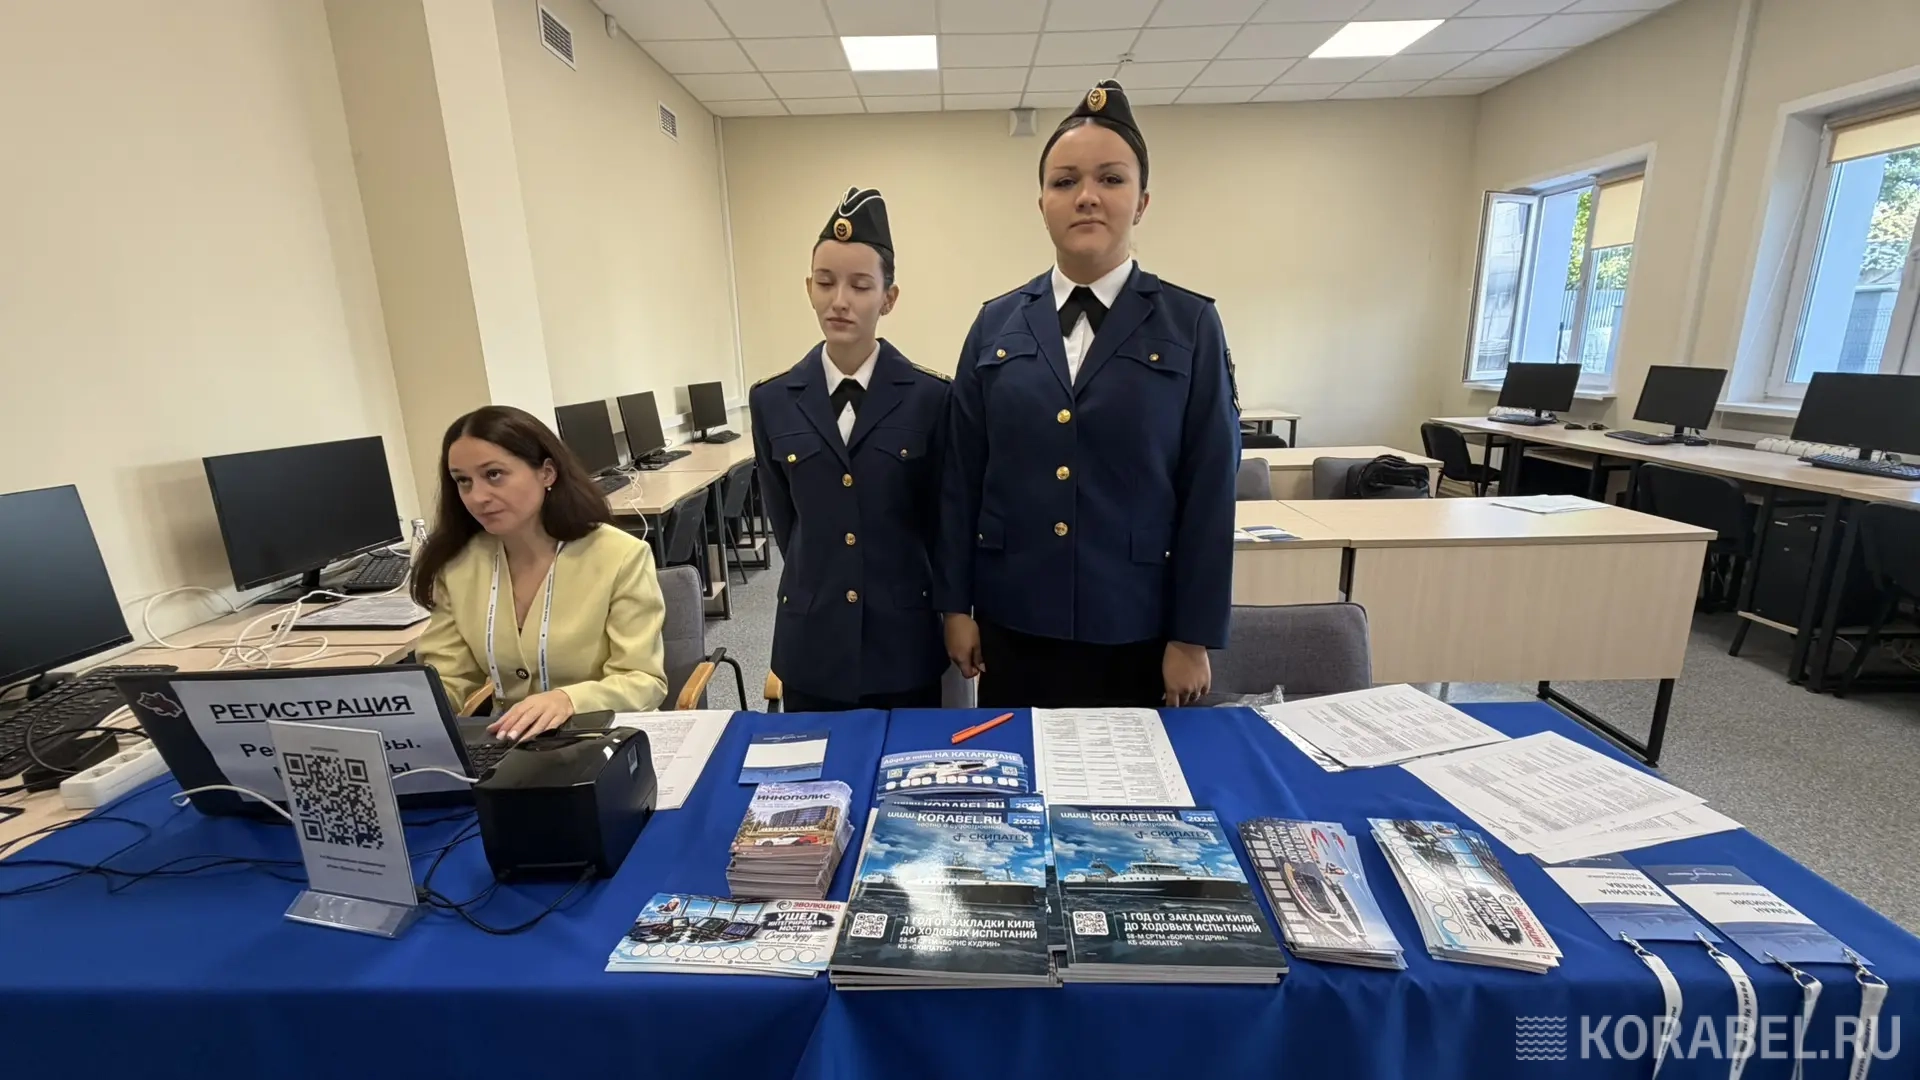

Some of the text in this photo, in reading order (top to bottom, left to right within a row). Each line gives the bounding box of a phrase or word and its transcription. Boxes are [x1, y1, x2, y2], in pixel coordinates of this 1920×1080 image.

[209, 695, 413, 720] РЕГИСТРАЦИЯ
[935, 751, 948, 759] НА
[951, 751, 1019, 761] КАТАМАРАНЕ
[757, 793, 831, 801] ИННОПОЛИС
[969, 833, 1029, 841] СКИПАТЕХ
[1150, 830, 1210, 838] СКИПАТЕХ
[1598, 888, 1662, 897] ЕКАТЕРИНА
[793, 902, 841, 910] ЭВОЛЮЦИЯ
[777, 912, 819, 921] УШЕЛ
[1130, 913, 1152, 922] ГОД
[1154, 913, 1167, 921] ОТ
[1169, 914, 1225, 923] ЗАКЛАДКИ
[1226, 914, 1255, 923] КИЛЯ
[912, 917, 933, 927] ГОД
[935, 918, 948, 926] ОТ
[949, 918, 1005, 929] ЗАКЛАДКИ
[1007, 920, 1035, 929] КИЛЯ
[1124, 922, 1262, 933] ДО ХОДОВЫХ ИСПЫТАНИЙ
[900, 926, 1038, 939] ДО ХОДОВЫХ ИСПЫТАНИЙ
